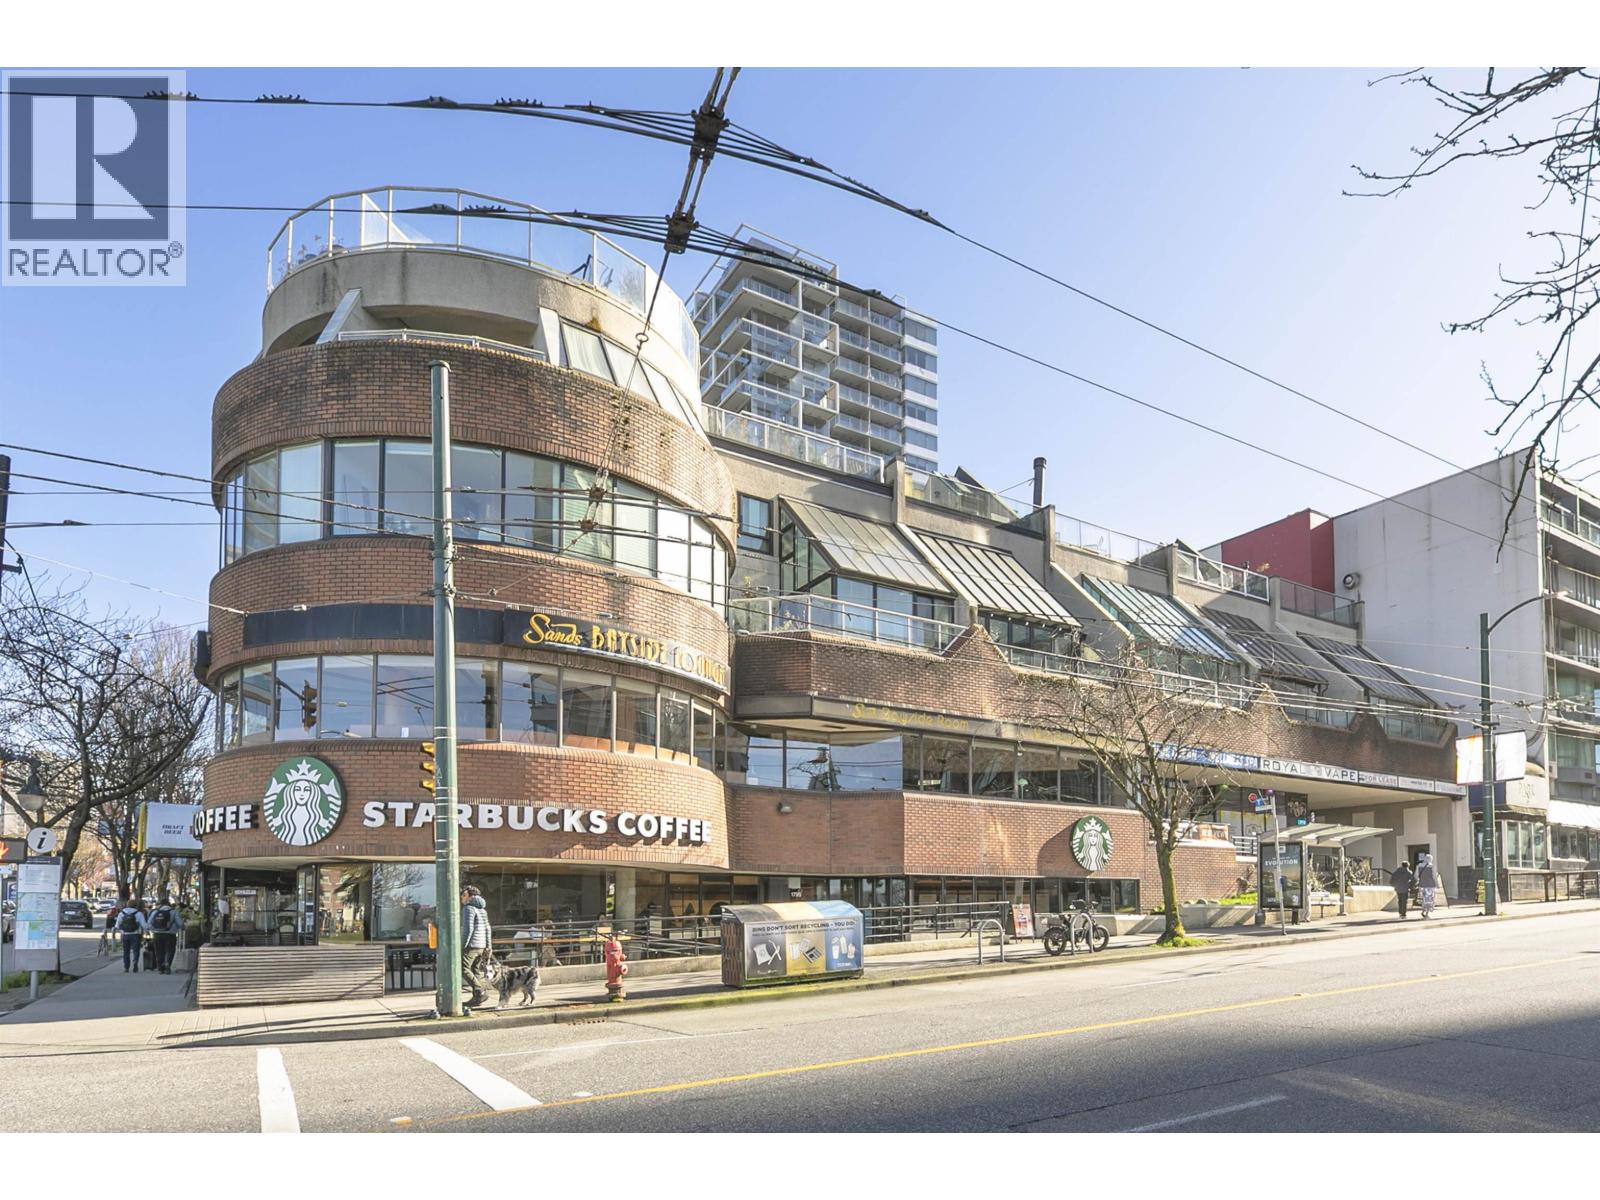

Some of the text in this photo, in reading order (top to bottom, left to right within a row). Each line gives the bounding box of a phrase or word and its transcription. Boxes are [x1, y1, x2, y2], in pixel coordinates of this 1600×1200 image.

[522, 613, 583, 647] Sands
[591, 625, 669, 665] BAYSIDE
[937, 715, 969, 731] Room
[1262, 759, 1356, 781] ROYAL VAPE
[194, 804, 252, 836] COFFEE
[363, 801, 608, 835] STARBUCKS
[617, 811, 713, 843] COFFEE
